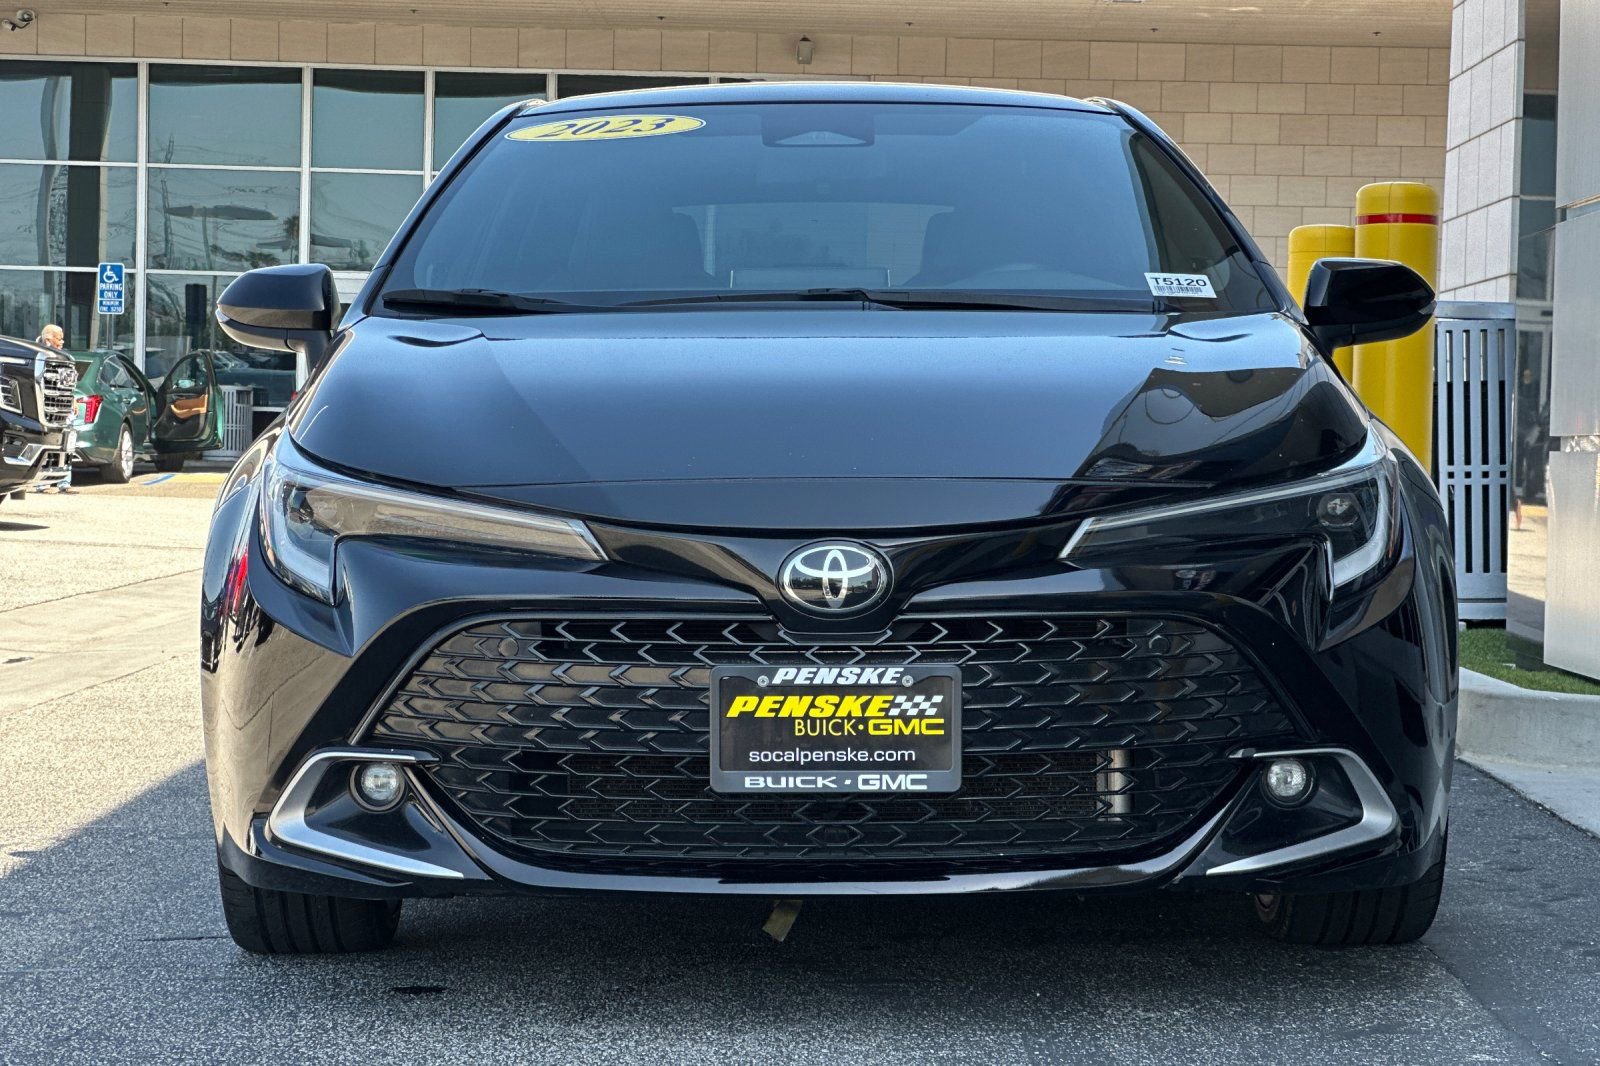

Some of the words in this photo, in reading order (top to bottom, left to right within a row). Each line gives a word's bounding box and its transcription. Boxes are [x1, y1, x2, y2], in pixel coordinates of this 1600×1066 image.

[534, 118, 676, 138] 2023
[99, 283, 123, 291] PARKING
[1150, 277, 1207, 287] T5120
[771, 667, 905, 685] PENSKE
[725, 694, 894, 718] PENSKE
[748, 747, 916, 765] socalpenske.com
[744, 775, 838, 789] BUICK
[857, 773, 928, 791] GMC
